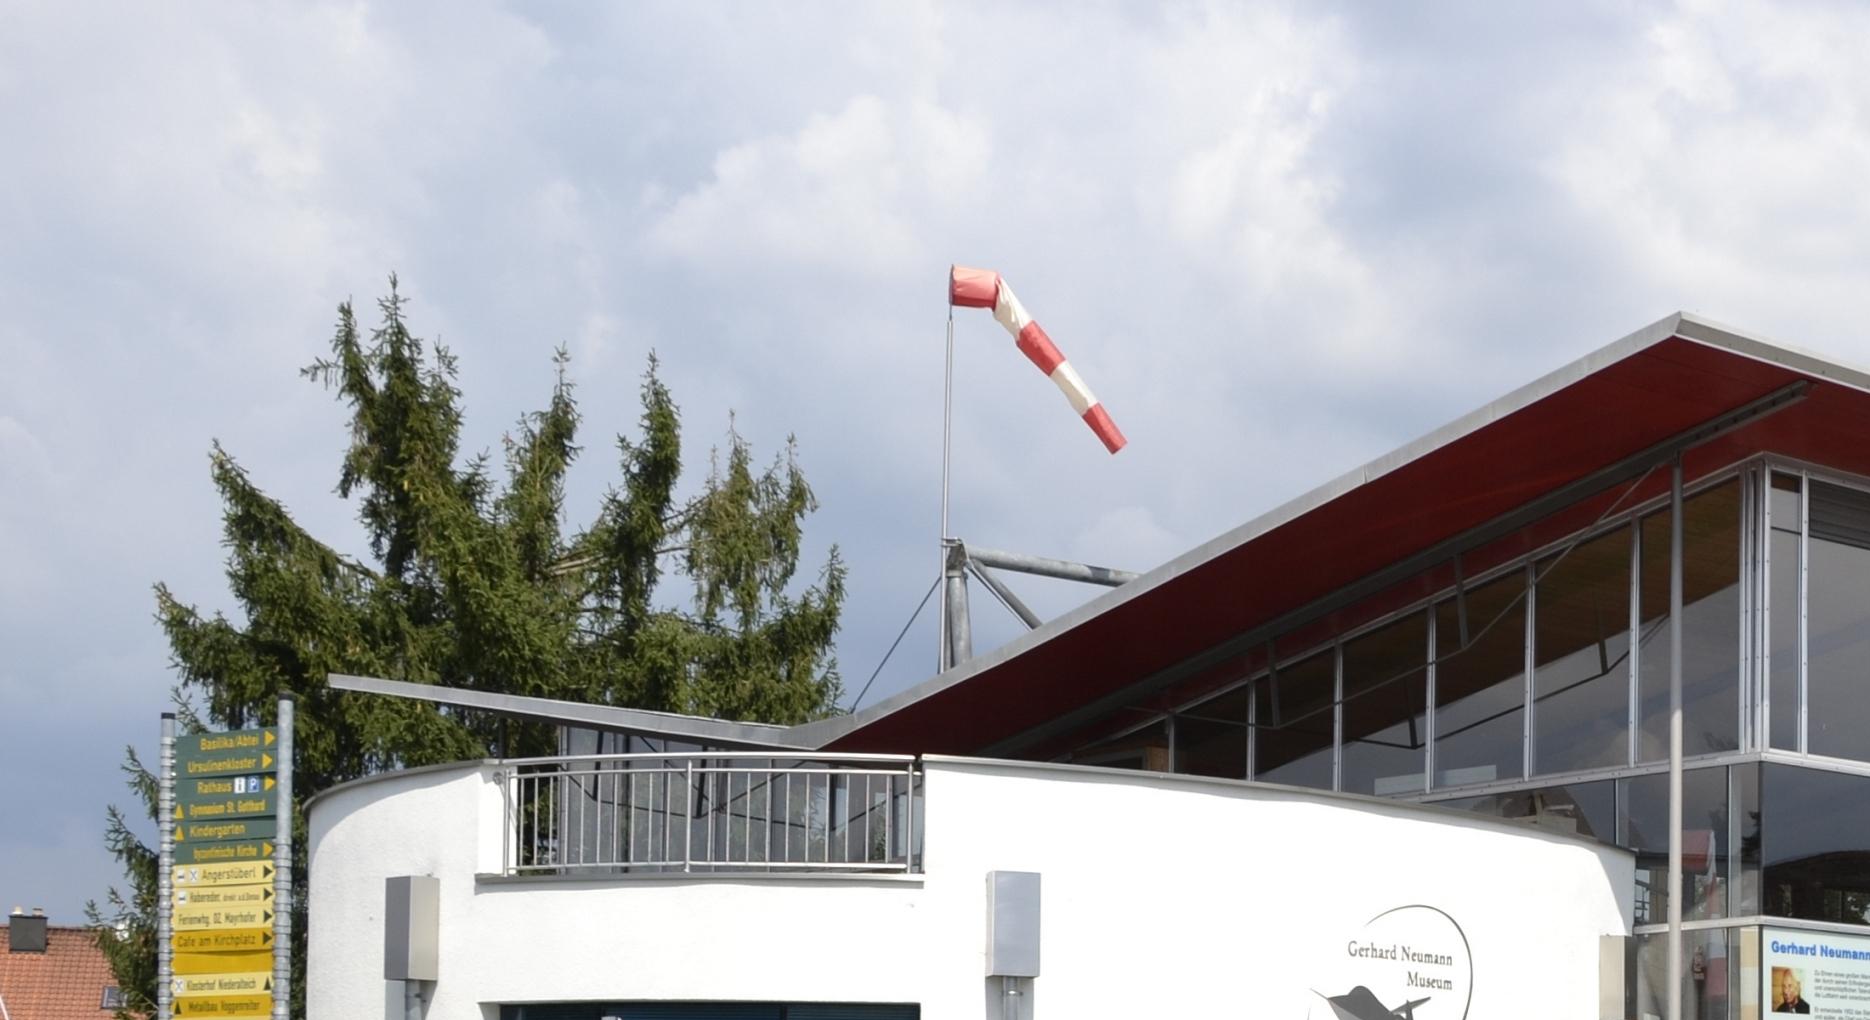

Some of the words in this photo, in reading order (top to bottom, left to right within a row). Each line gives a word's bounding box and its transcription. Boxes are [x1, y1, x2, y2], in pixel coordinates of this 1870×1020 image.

[201, 734, 259, 751] Basilika/Abtei
[188, 759, 256, 773] Ursulinenkloster
[197, 781, 232, 794] Rathaus
[190, 824, 245, 838] Kindergarten
[202, 866, 256, 884] Angerstüberl
[199, 937, 211, 946] am
[214, 933, 256, 947] Kirchplatz
[1771, 940, 1816, 957] Gerhard
[1348, 940, 1397, 961] Gerhard
[1401, 946, 1453, 966] Neumann
[1407, 971, 1453, 991] Museum
